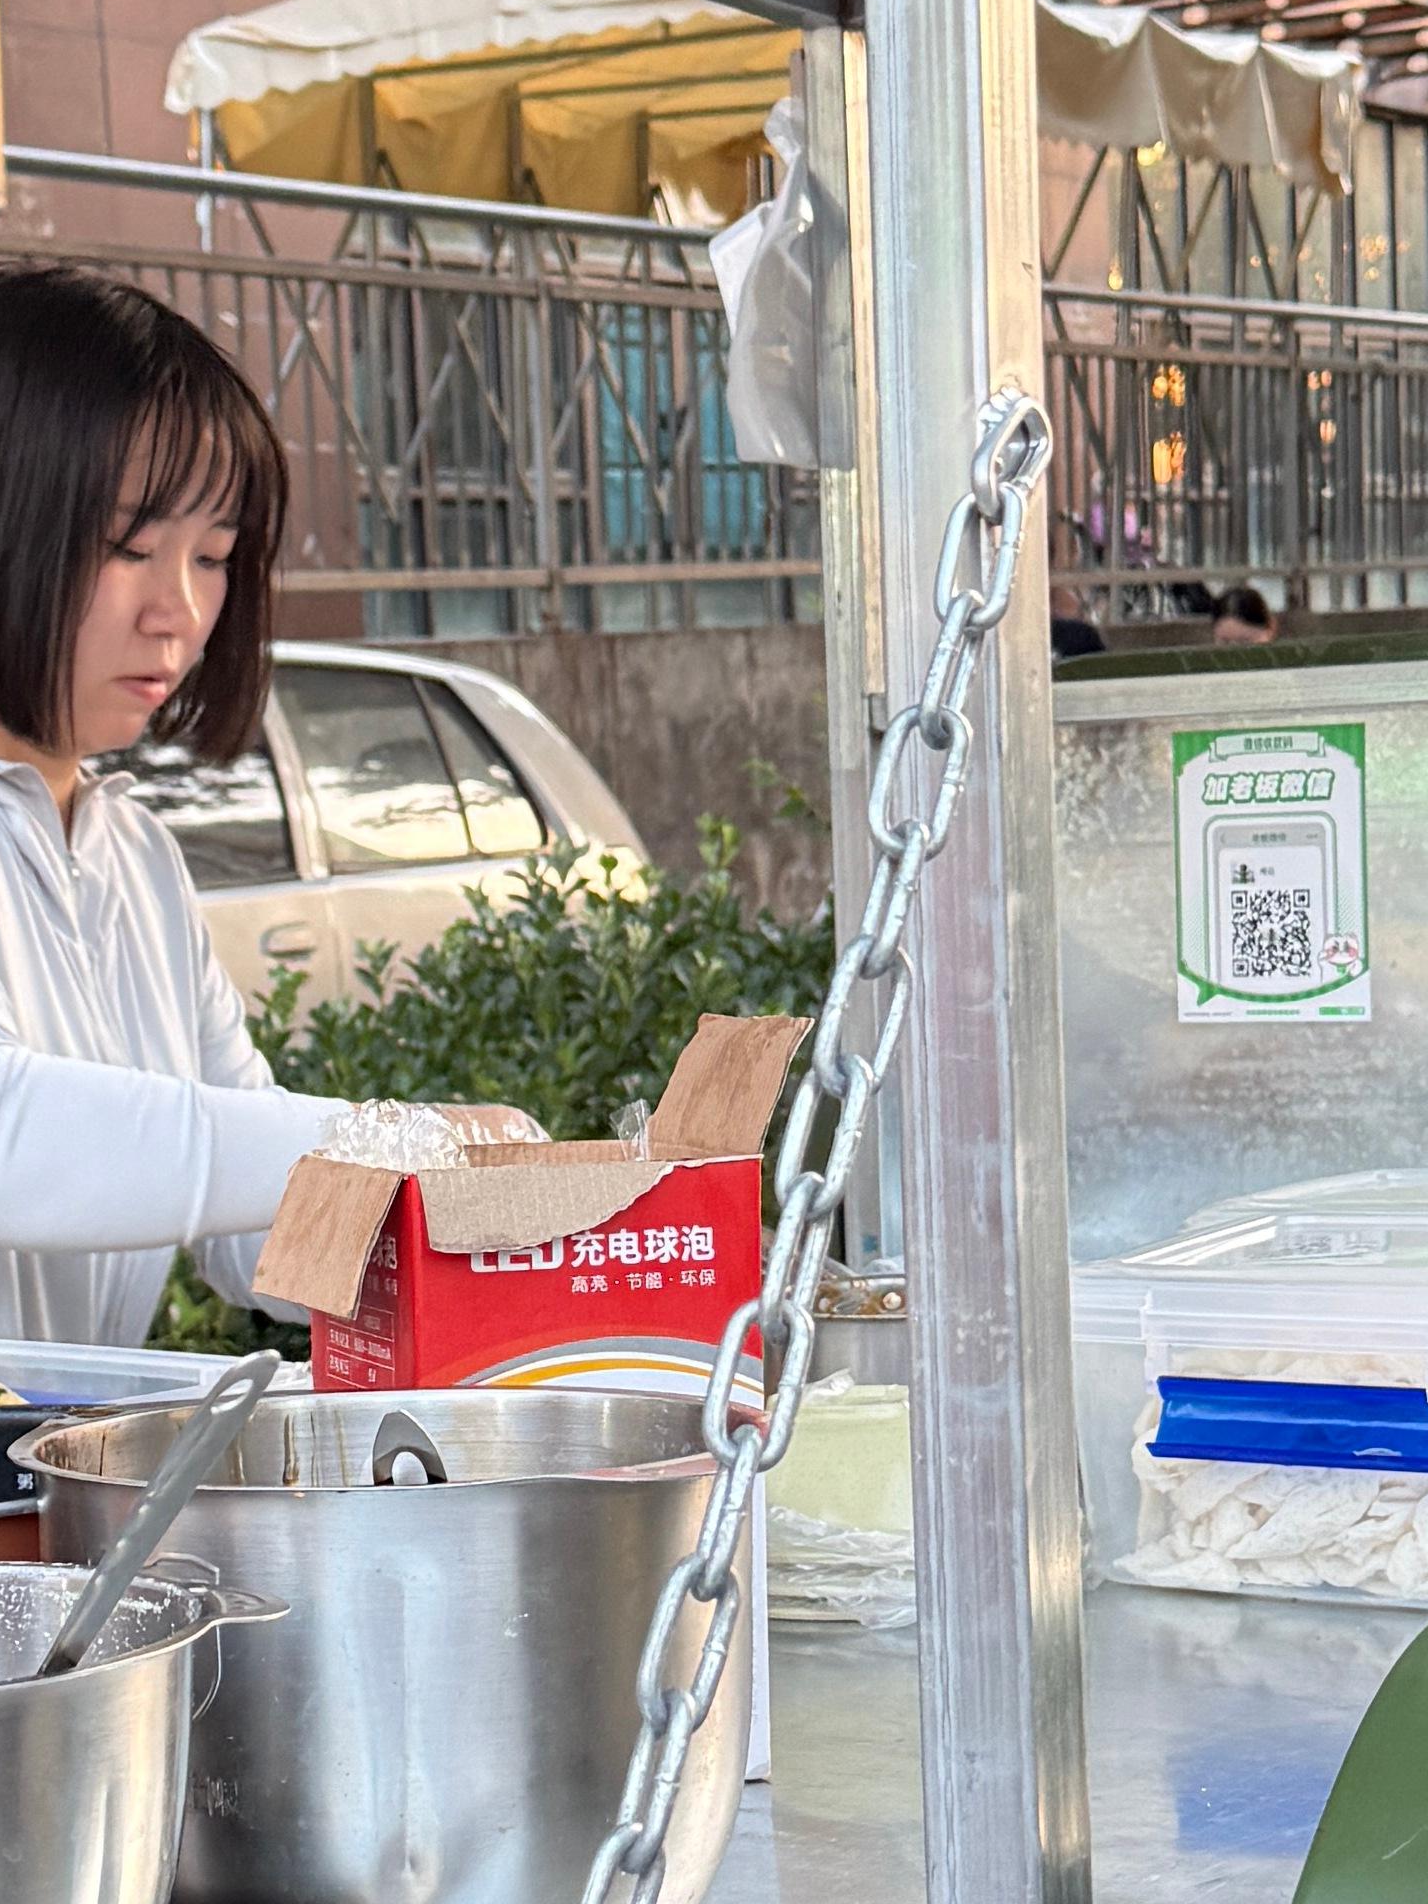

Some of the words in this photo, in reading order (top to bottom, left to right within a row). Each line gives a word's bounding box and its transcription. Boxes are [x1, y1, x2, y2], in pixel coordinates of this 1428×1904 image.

[1202, 769, 1335, 805] 加老板微信
[571, 1224, 716, 1267] 充电球泡
